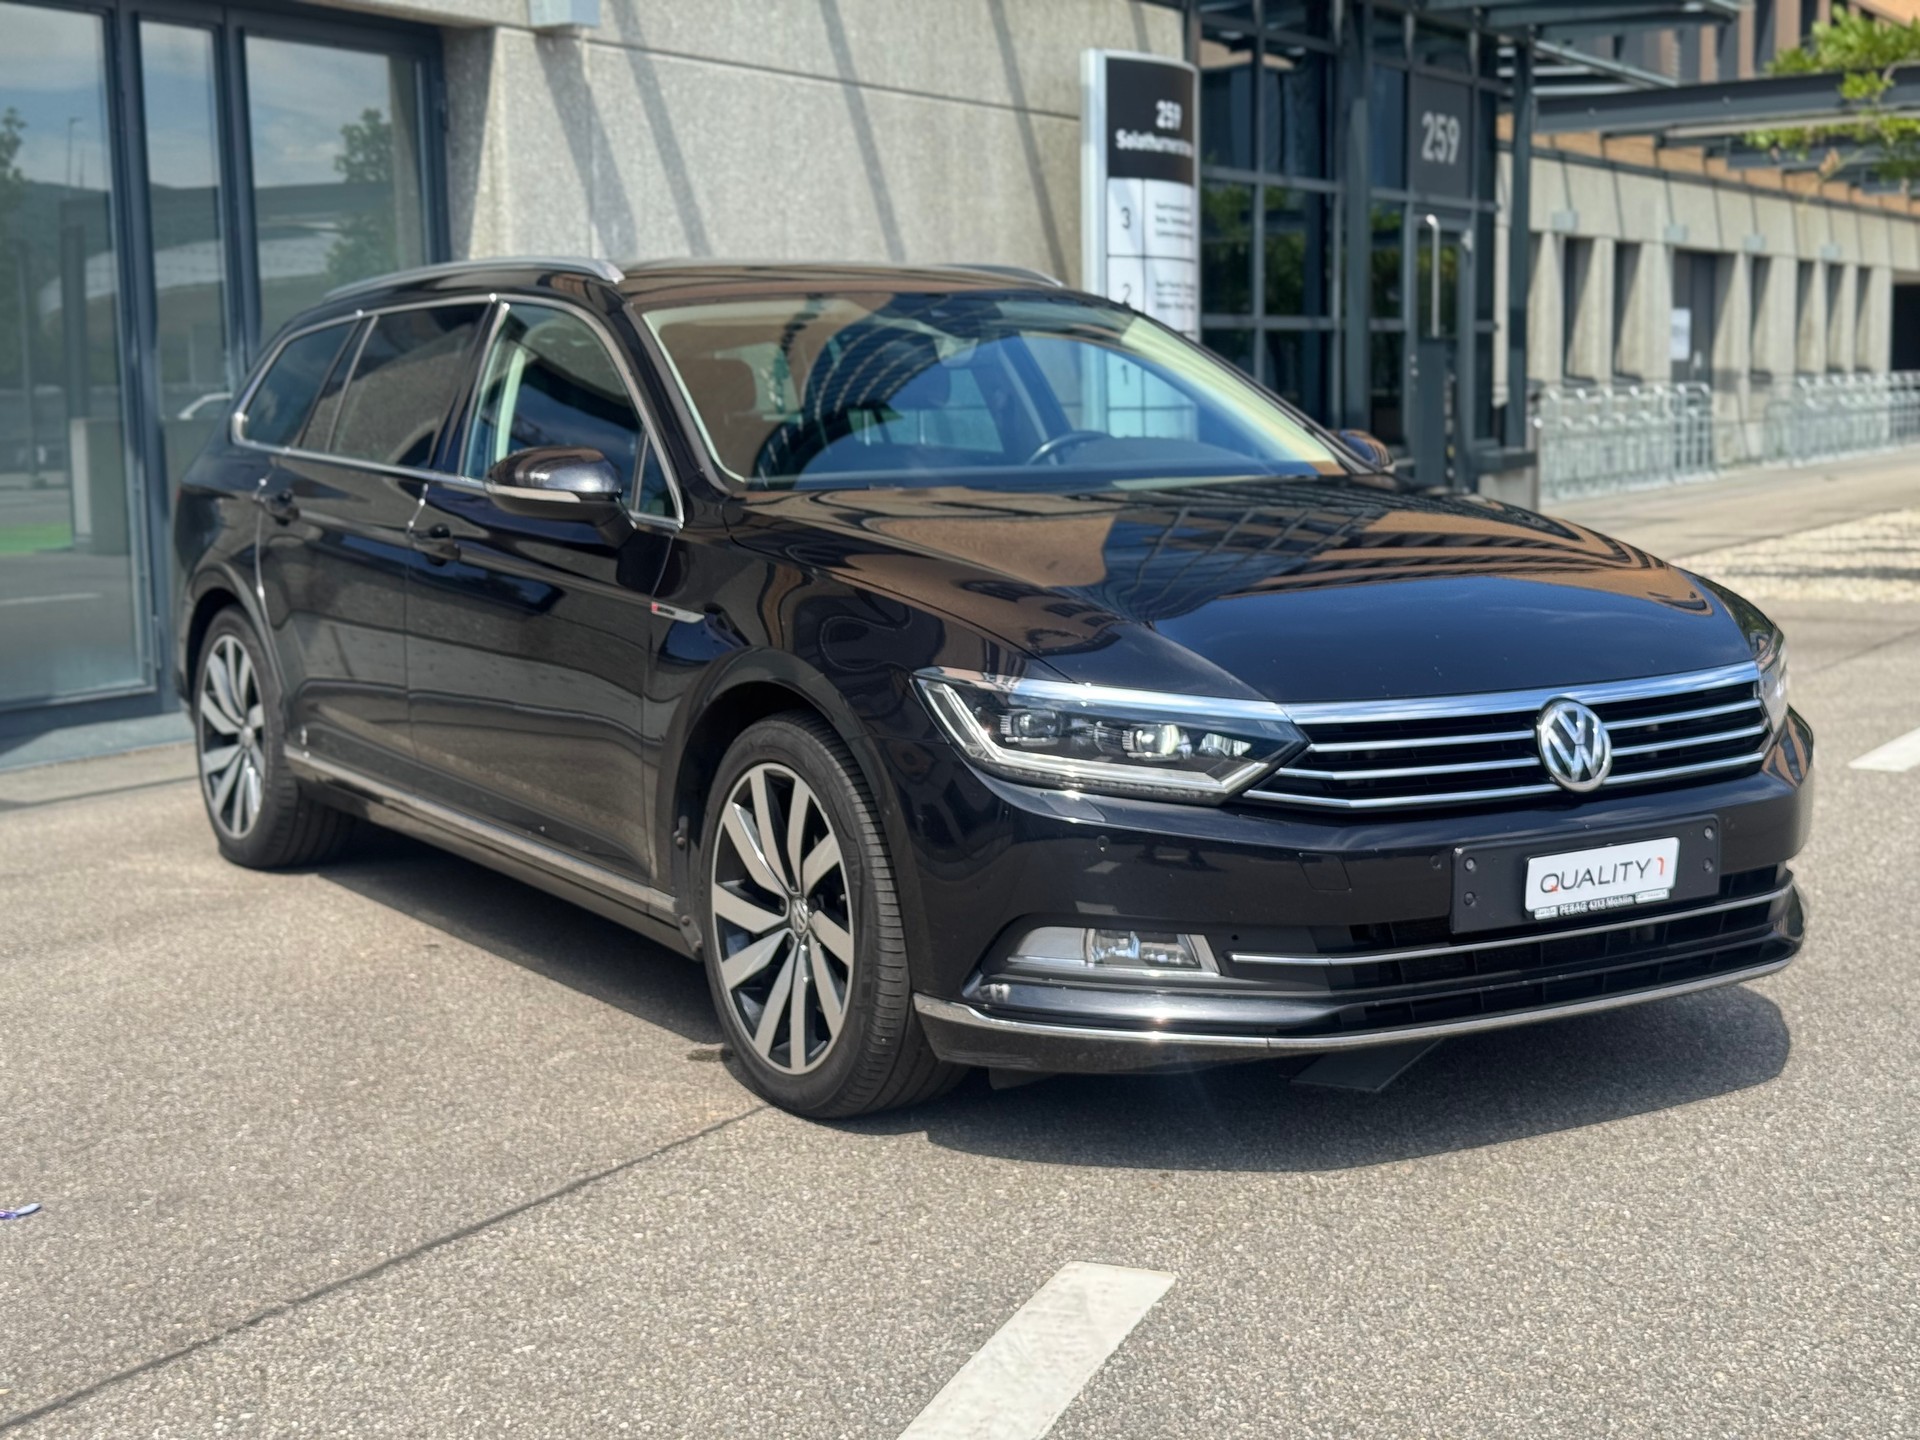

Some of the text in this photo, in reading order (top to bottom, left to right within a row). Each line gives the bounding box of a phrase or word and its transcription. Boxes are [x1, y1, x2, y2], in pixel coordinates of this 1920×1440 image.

[1155, 99, 1182, 131] 259
[1421, 111, 1461, 165] 259
[1121, 206, 1132, 230] 3
[1544, 704, 1607, 786] VW
[1540, 858, 1652, 894] QUALITY
